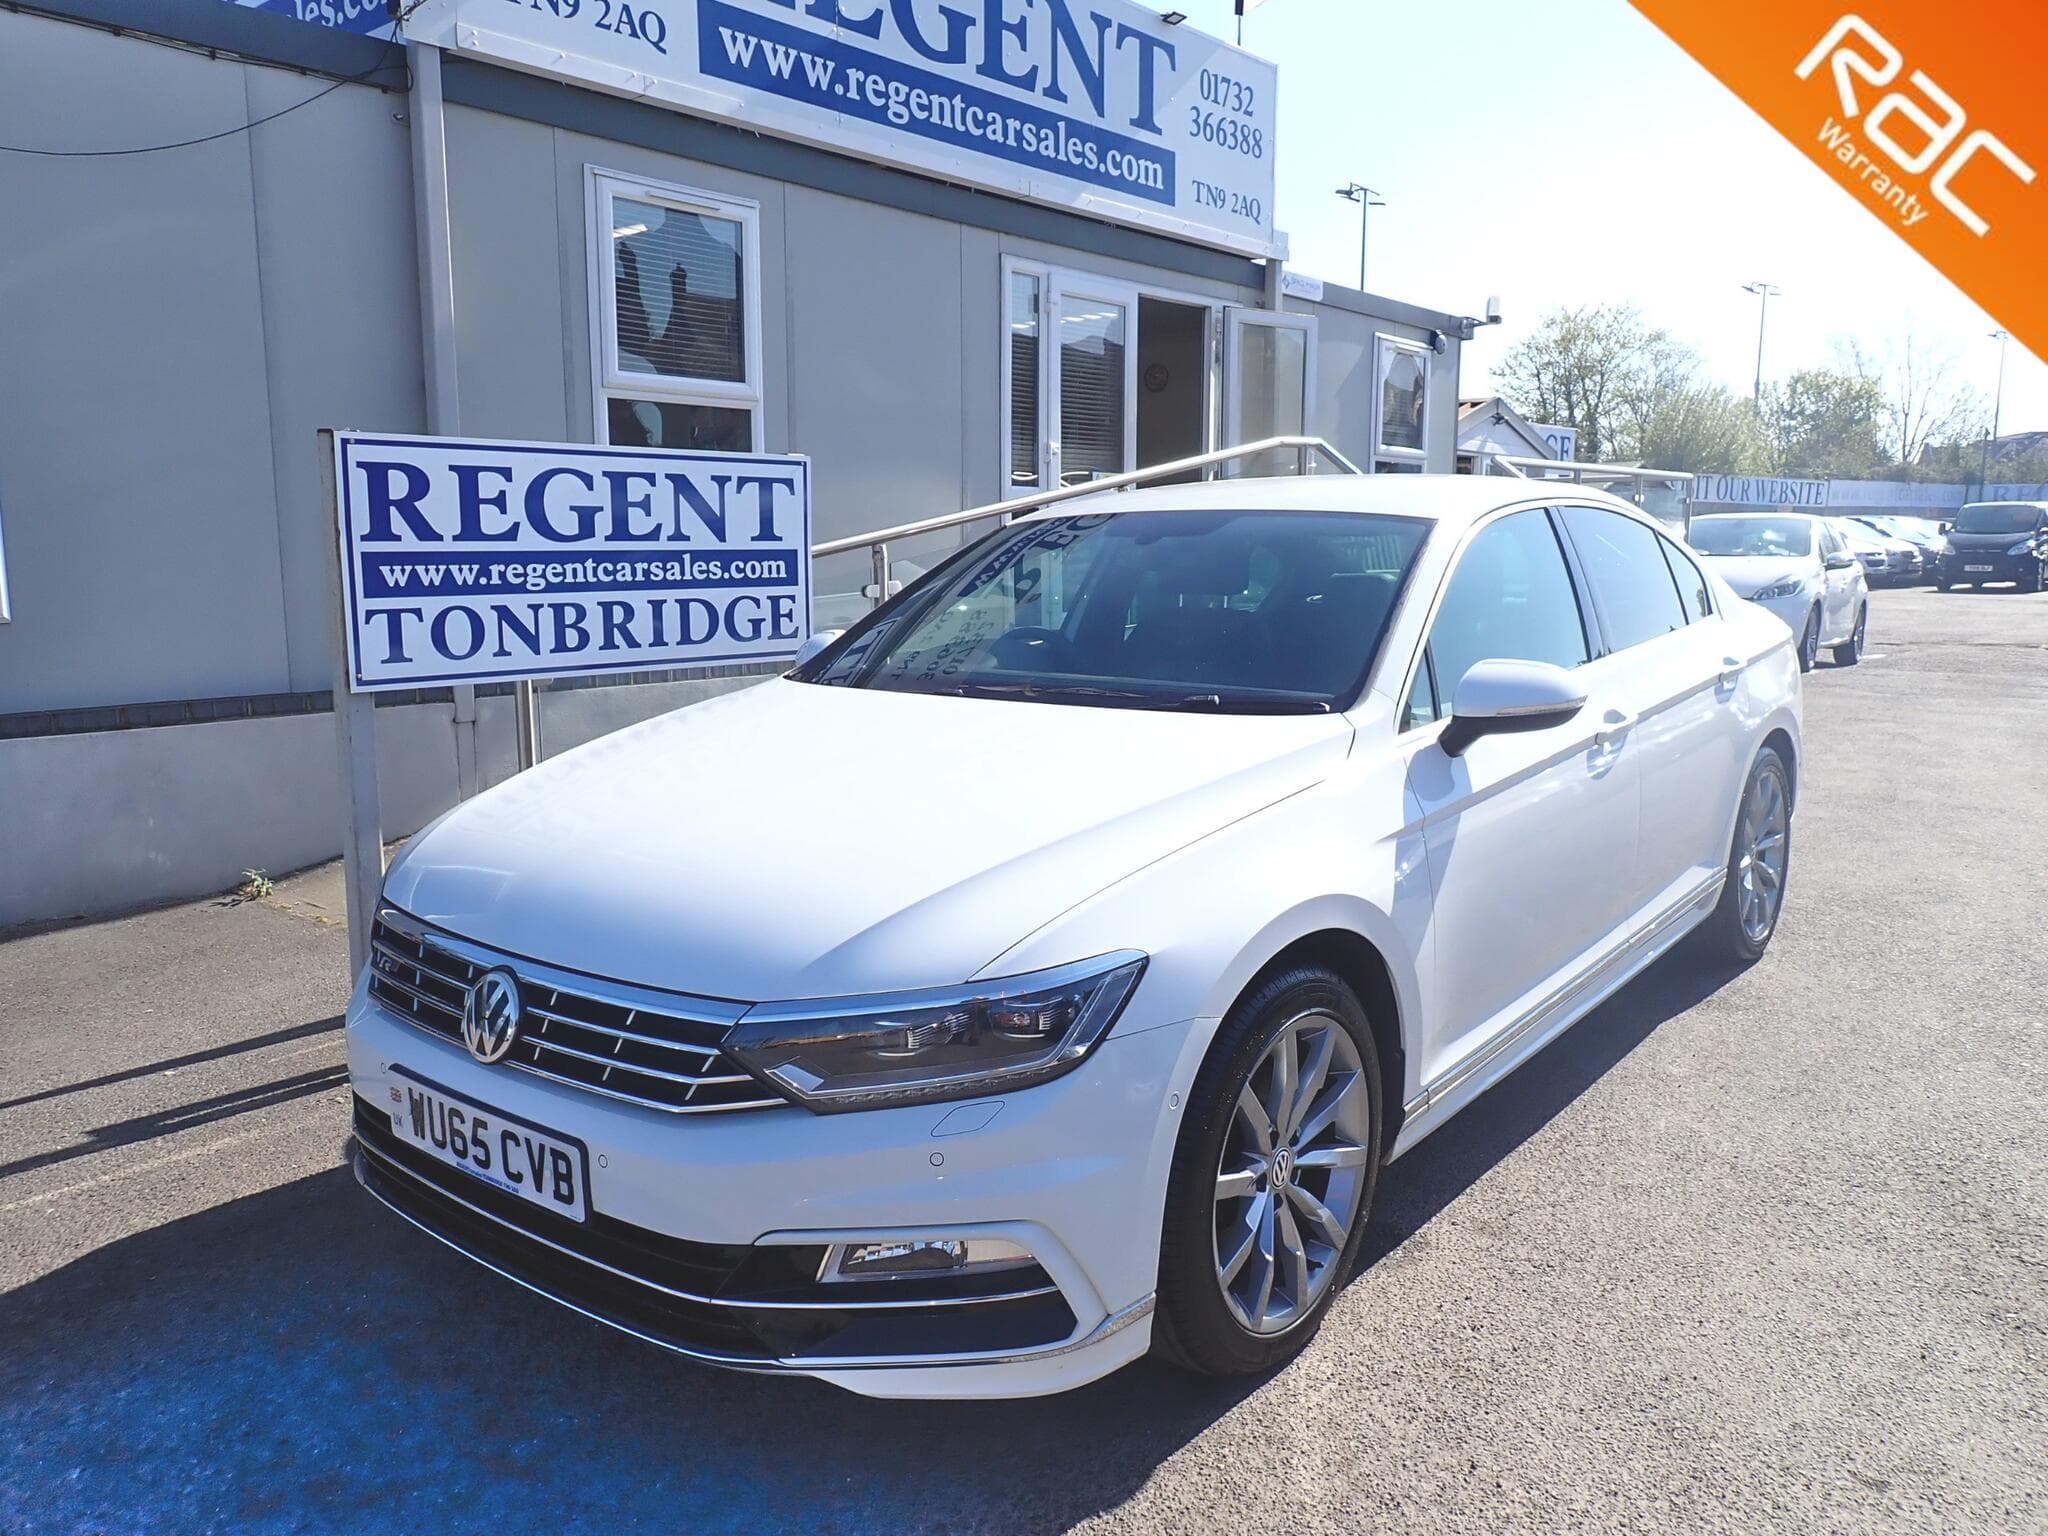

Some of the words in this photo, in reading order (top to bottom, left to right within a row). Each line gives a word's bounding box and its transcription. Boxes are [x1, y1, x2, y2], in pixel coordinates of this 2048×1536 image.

[510, 0, 580, 19] N9
[594, 0, 667, 55] 2AQ
[767, 0, 1176, 136] GENT
[1200, 68, 1254, 117] 01732
[718, 26, 1164, 190] www.regentcarsales.com
[1189, 106, 1262, 159] 366388
[1192, 180, 1226, 209] TN9
[1231, 193, 1261, 225] 2AQ
[356, 461, 795, 543] REGENT
[1716, 475, 1750, 501] OUR
[1756, 480, 1825, 505] WEBSITE
[379, 553, 787, 591] www.regentcarsales.com
[365, 594, 800, 665] TONBRIDGE
[408, 1087, 491, 1170] WU65
[501, 1128, 574, 1206] CVB
